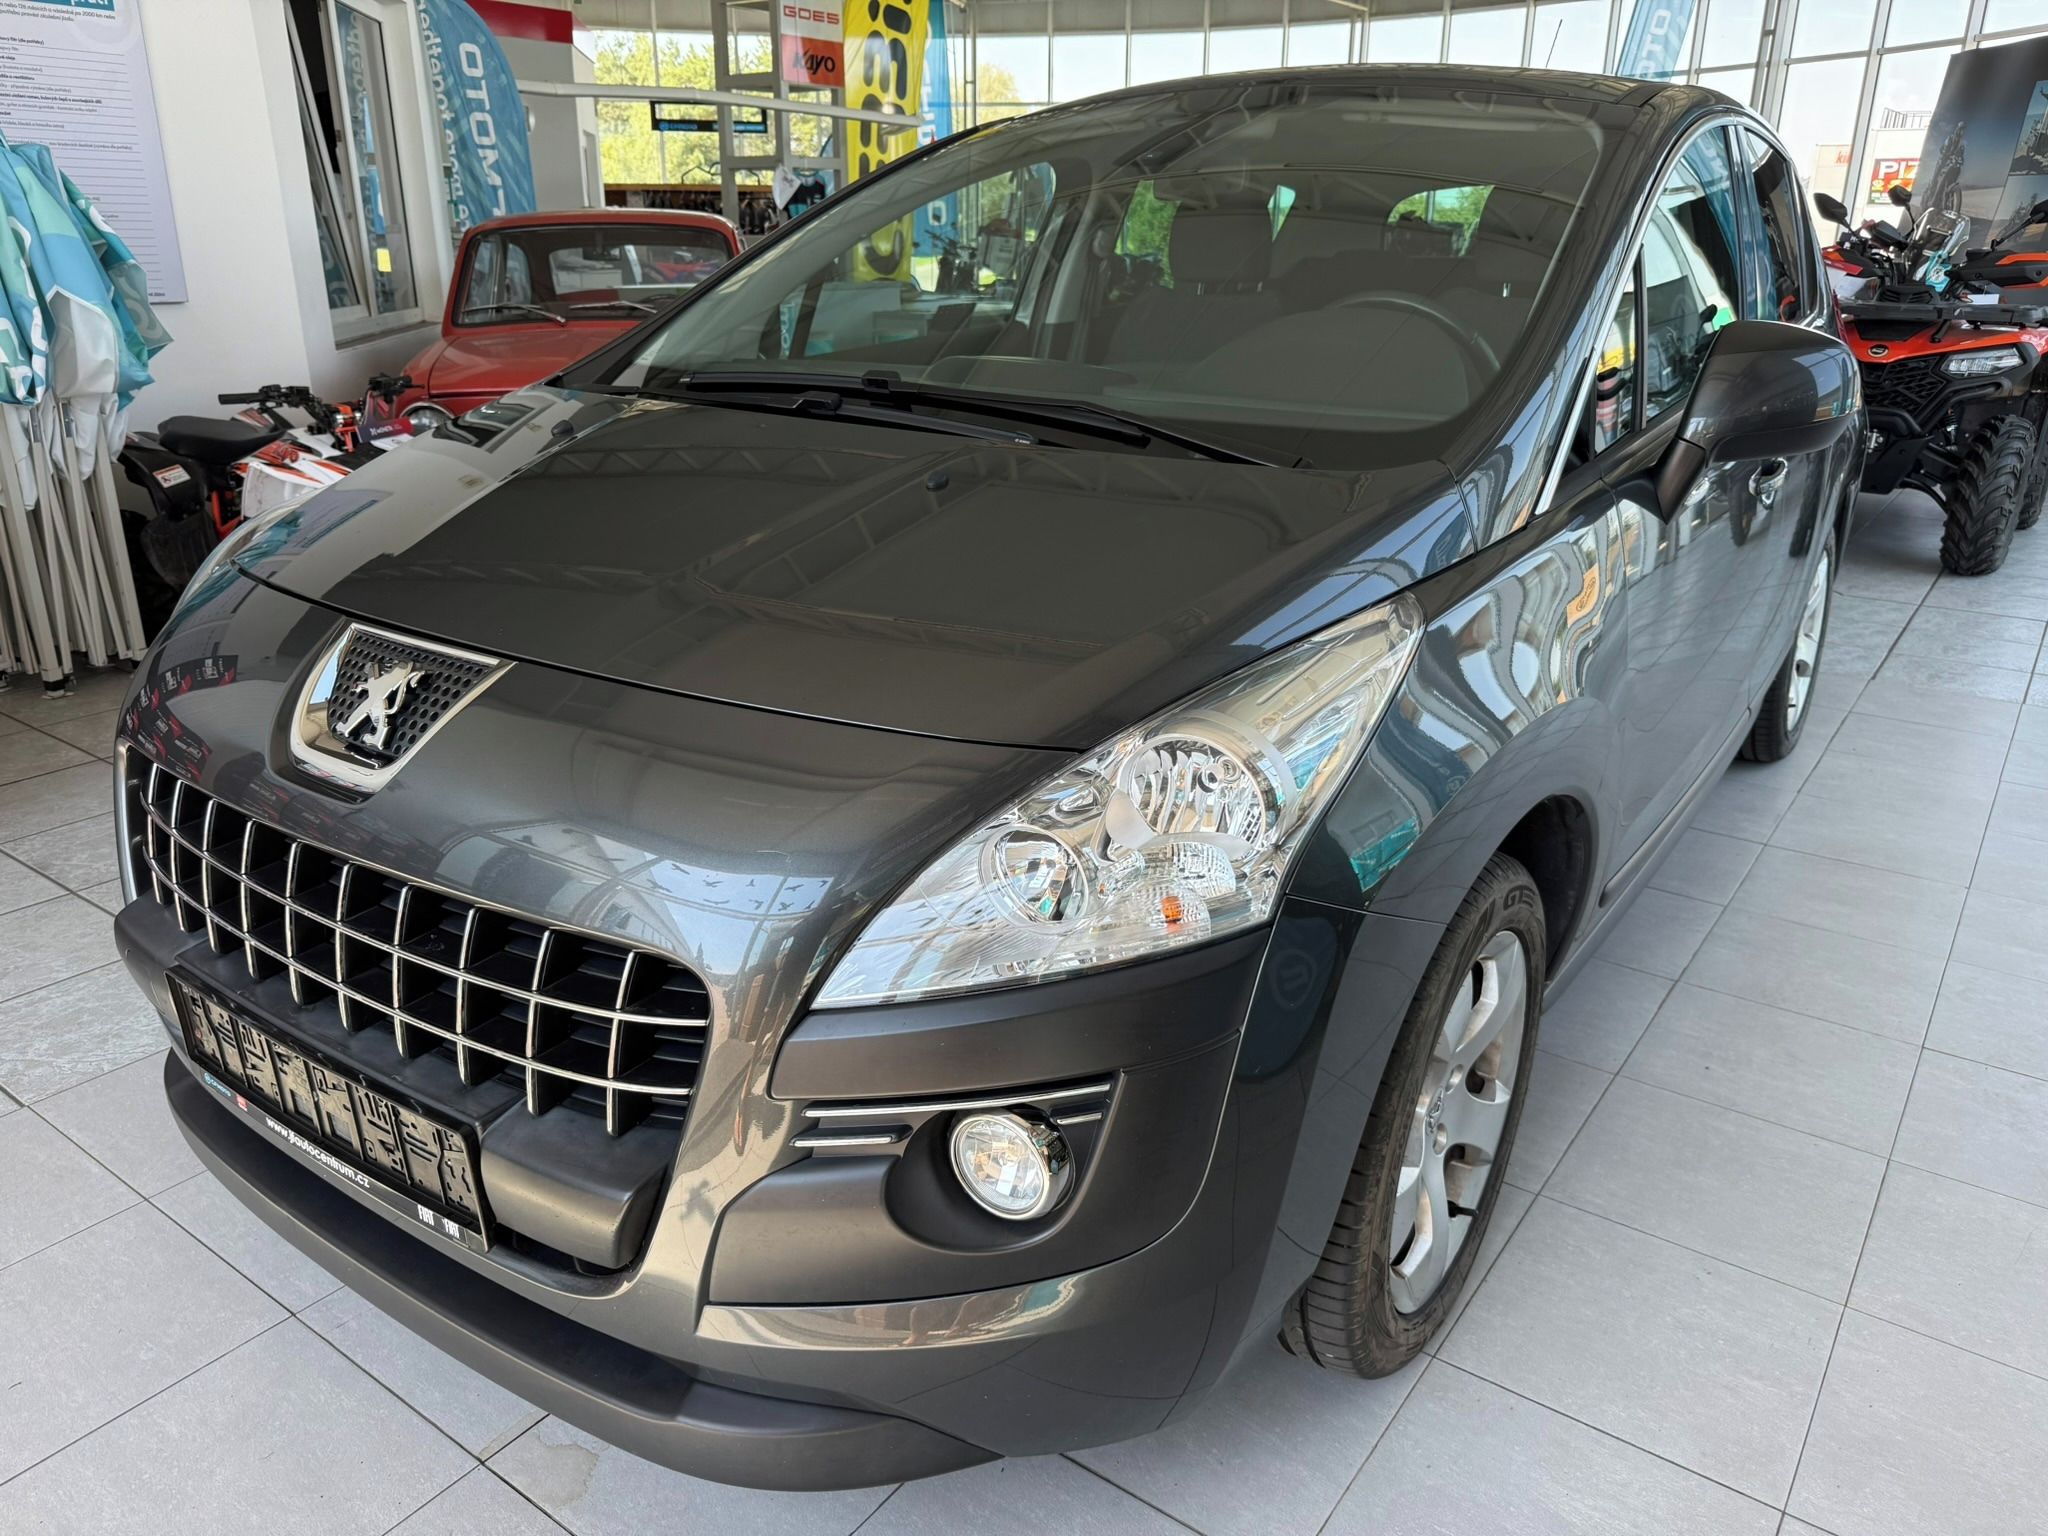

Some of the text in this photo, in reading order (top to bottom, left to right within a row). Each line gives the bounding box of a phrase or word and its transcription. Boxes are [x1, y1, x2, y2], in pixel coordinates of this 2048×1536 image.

[783, 5, 840, 25] GOES
[417, 1204, 435, 1226] FIAT
[442, 1218, 460, 1239] FIAT
